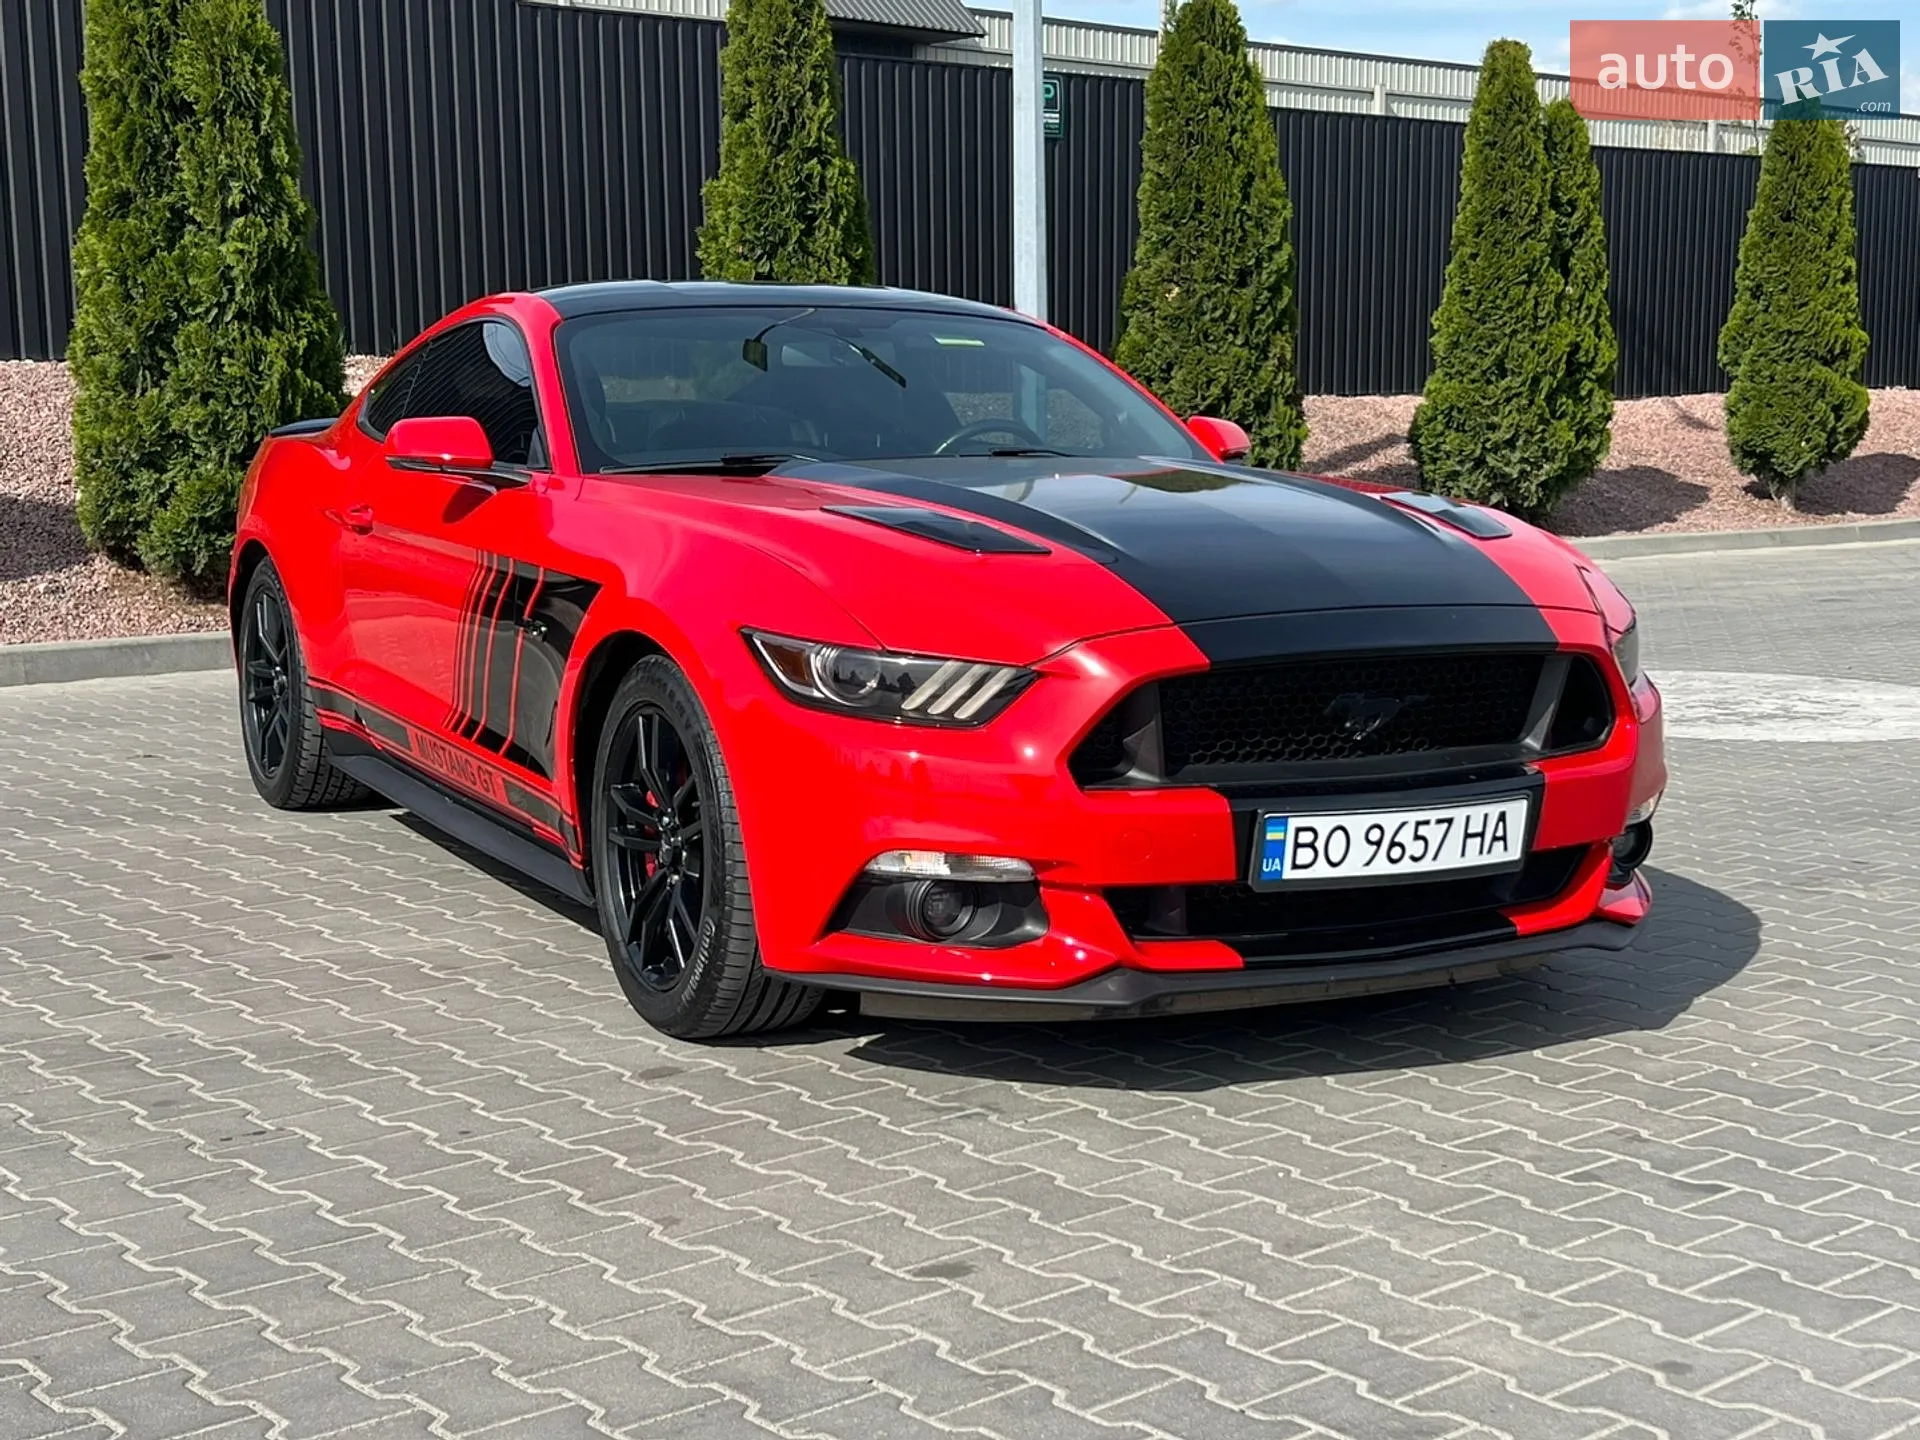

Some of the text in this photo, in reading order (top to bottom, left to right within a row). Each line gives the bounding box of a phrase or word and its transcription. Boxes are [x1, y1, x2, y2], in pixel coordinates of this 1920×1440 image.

[415, 732, 497, 797] MUSTANG GT
[1262, 857, 1281, 872] UA
[1290, 810, 1509, 870] BO 9657 HA
